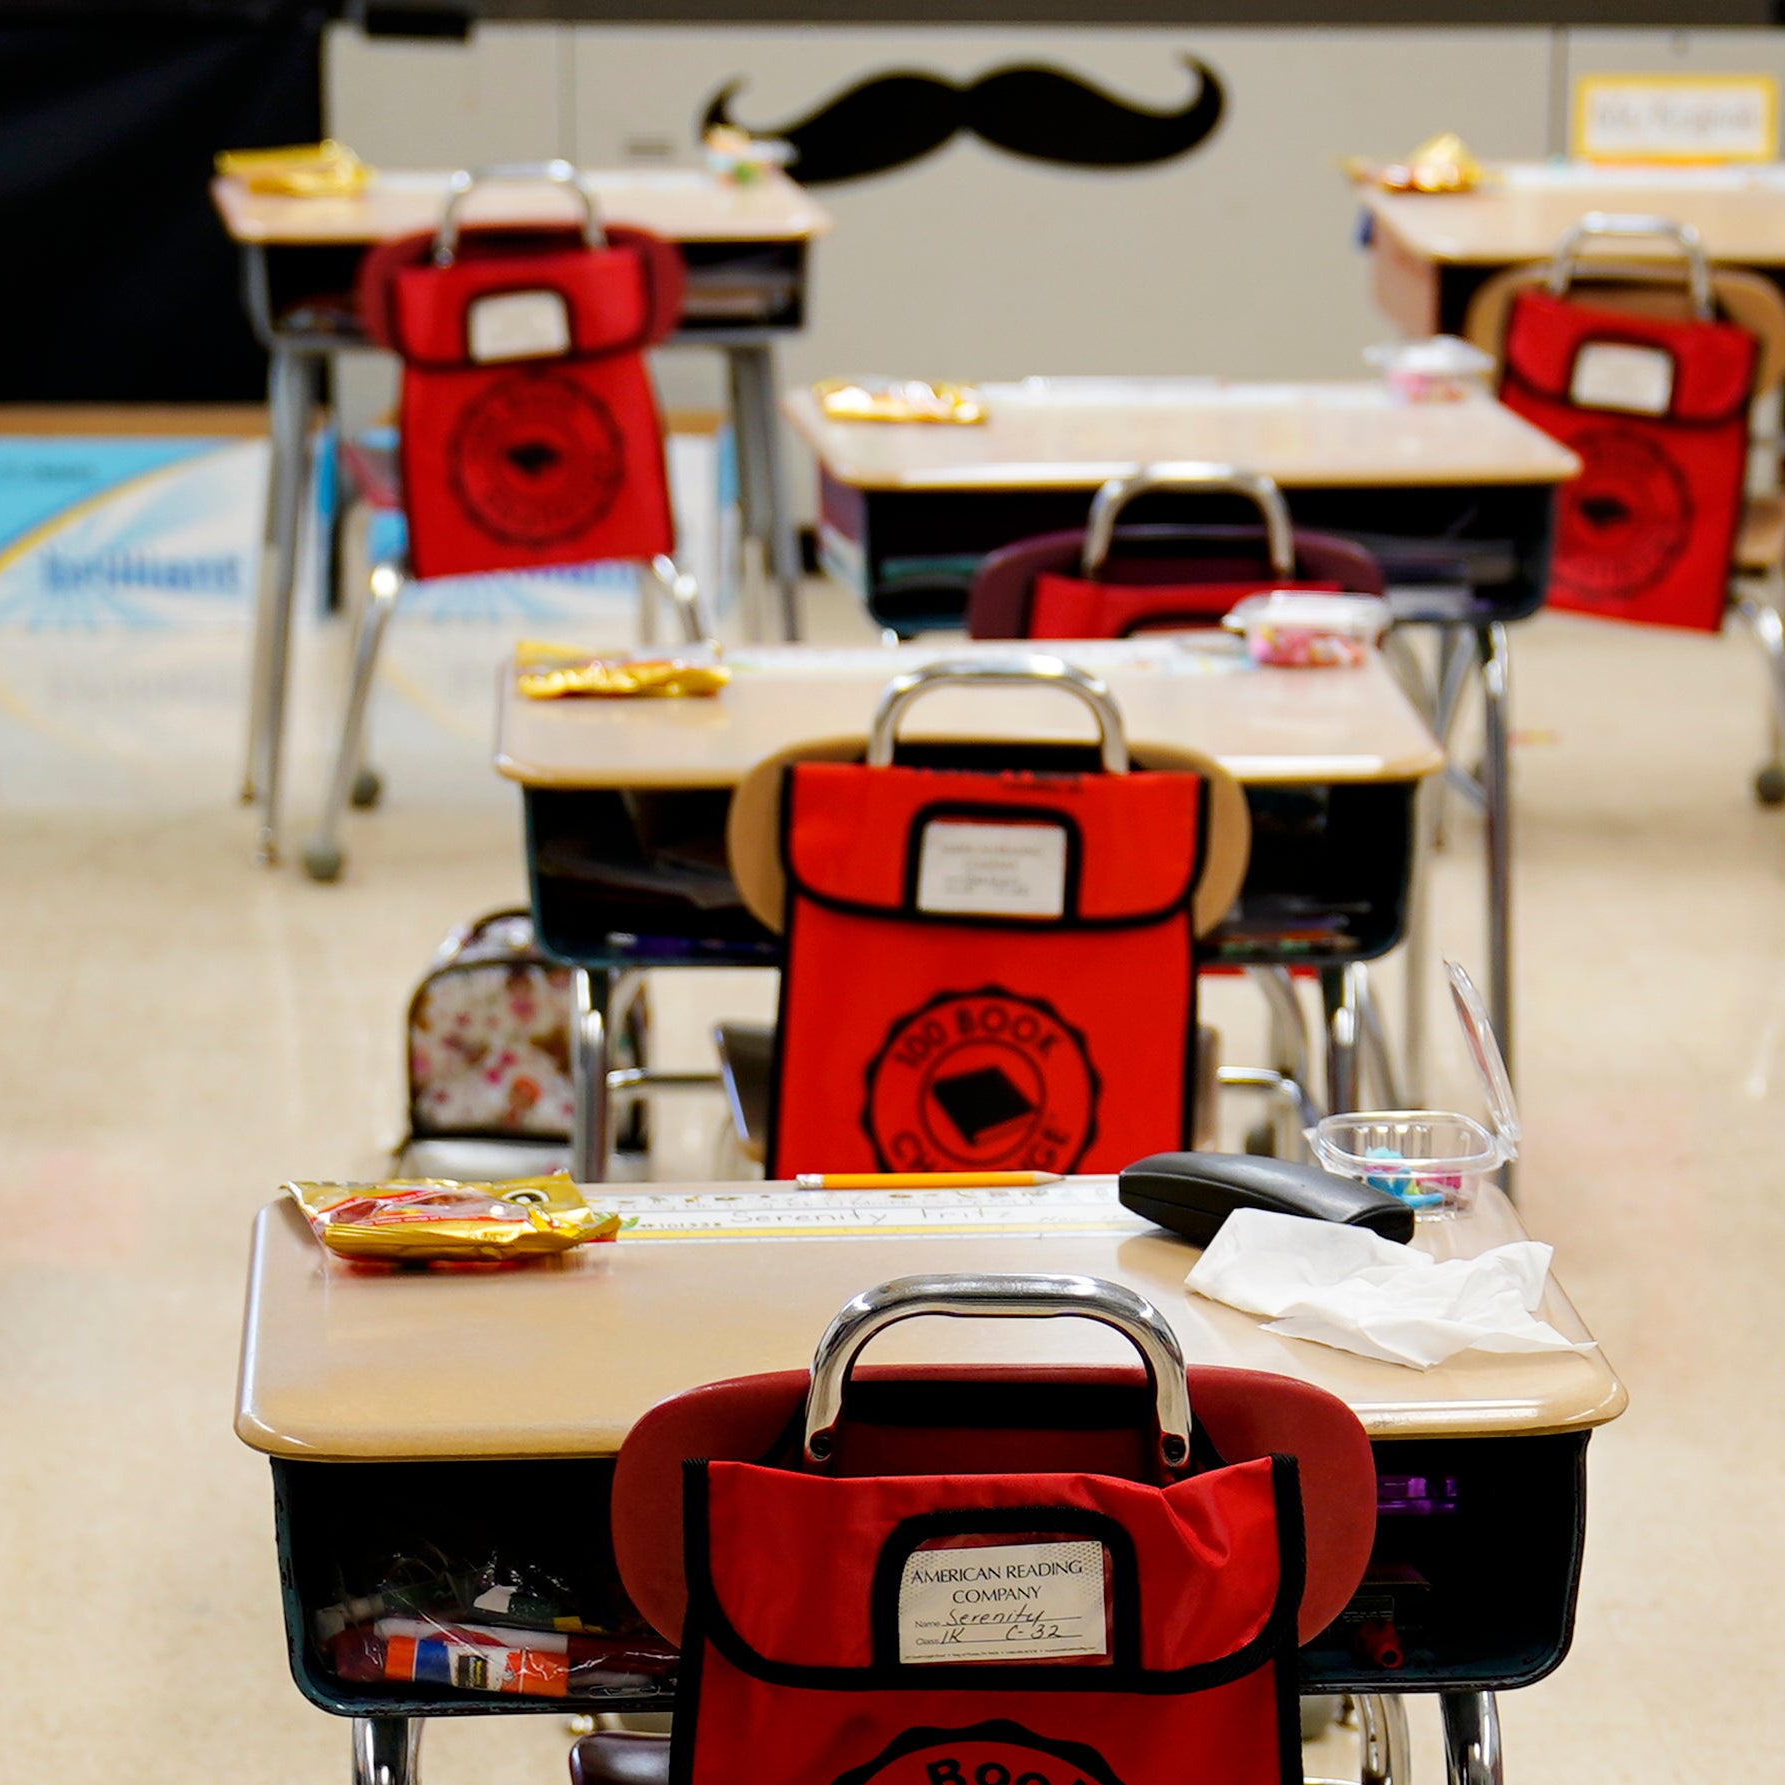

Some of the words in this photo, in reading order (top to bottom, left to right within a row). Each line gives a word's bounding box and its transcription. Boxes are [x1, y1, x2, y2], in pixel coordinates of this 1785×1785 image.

[911, 1565, 1001, 1585] AMERICAN
[1006, 1559, 1083, 1579] READING
[952, 1585, 1042, 1604] COMPANY
[944, 1603, 1045, 1627] Serenity
